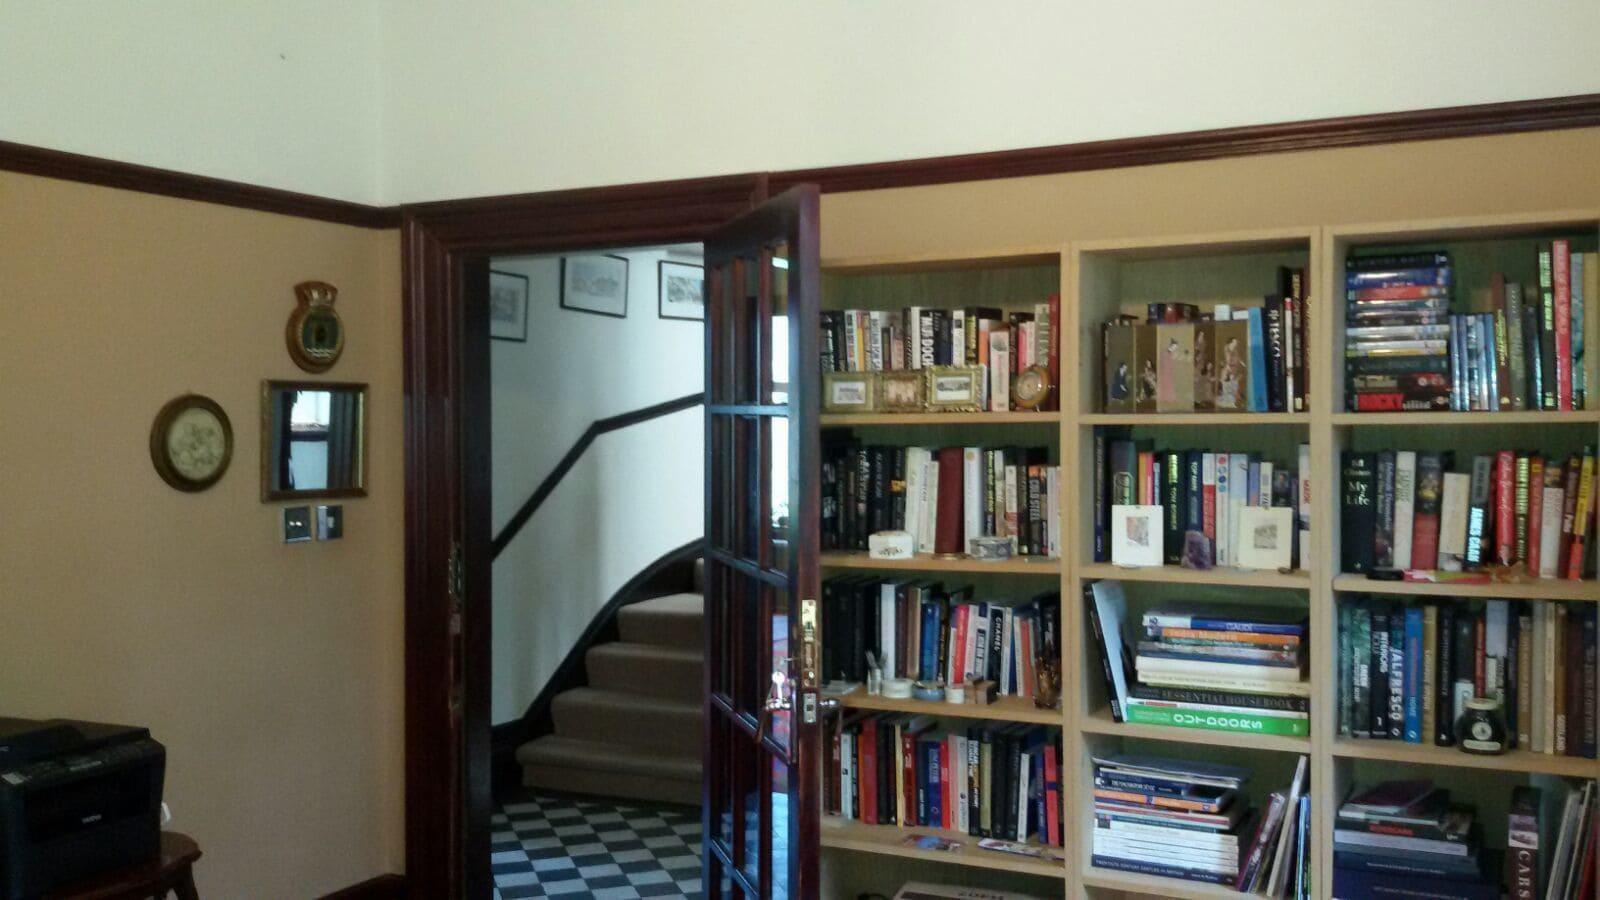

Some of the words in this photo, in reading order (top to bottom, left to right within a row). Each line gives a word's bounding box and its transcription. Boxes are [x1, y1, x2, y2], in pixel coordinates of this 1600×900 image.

[993, 616, 1003, 653] CHANEL
[1389, 652, 1403, 722] ALFRESCO
[1173, 712, 1263, 729] OUTDOORS
[1518, 850, 1532, 898] CARS
